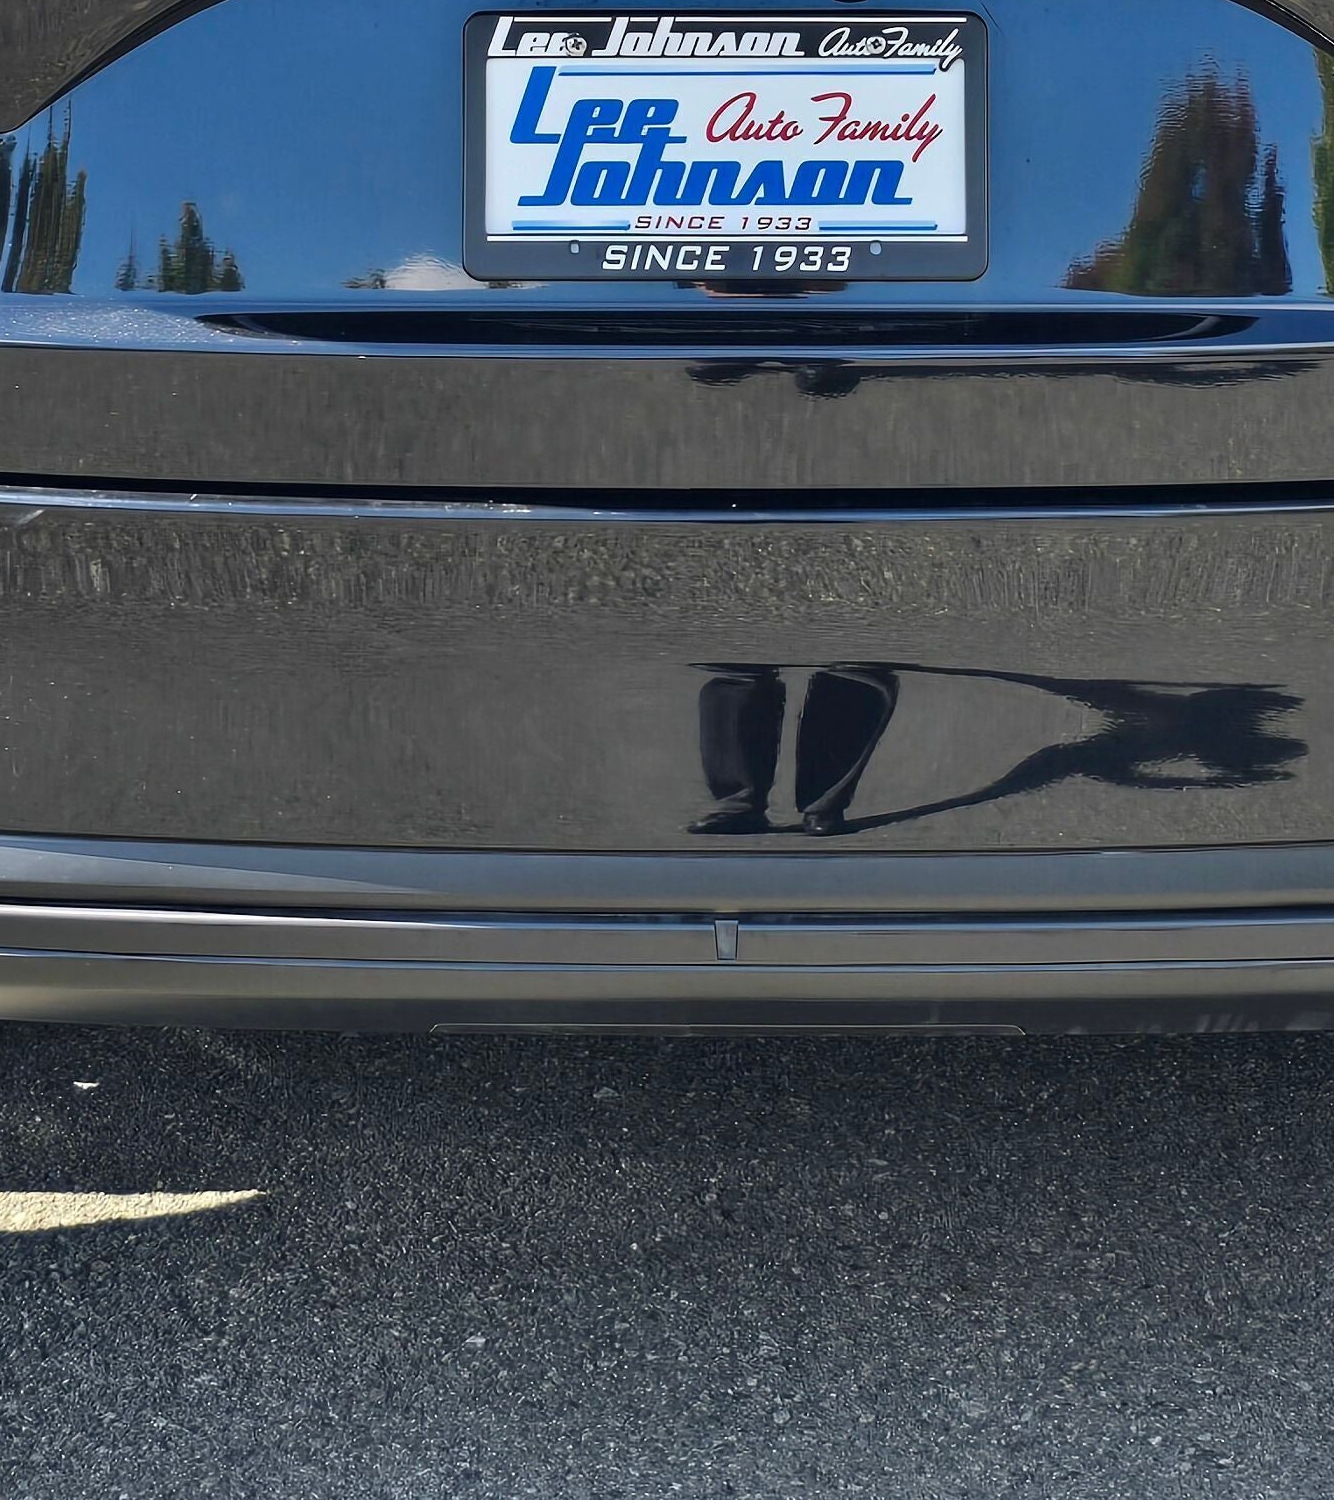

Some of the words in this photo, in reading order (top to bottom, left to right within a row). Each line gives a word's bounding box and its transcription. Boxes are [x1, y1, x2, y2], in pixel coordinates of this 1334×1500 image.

[592, 16, 805, 57] Johnson
[818, 26, 884, 57] Aut
[882, 26, 963, 69] Family
[509, 65, 687, 144] Lee
[705, 91, 804, 143] Auto
[810, 91, 944, 163] Family
[517, 143, 913, 207] Johnson
[634, 215, 726, 231] SINCE
[740, 215, 813, 231] 1933
[602, 244, 730, 272] SINCE
[751, 244, 853, 272] 1933
